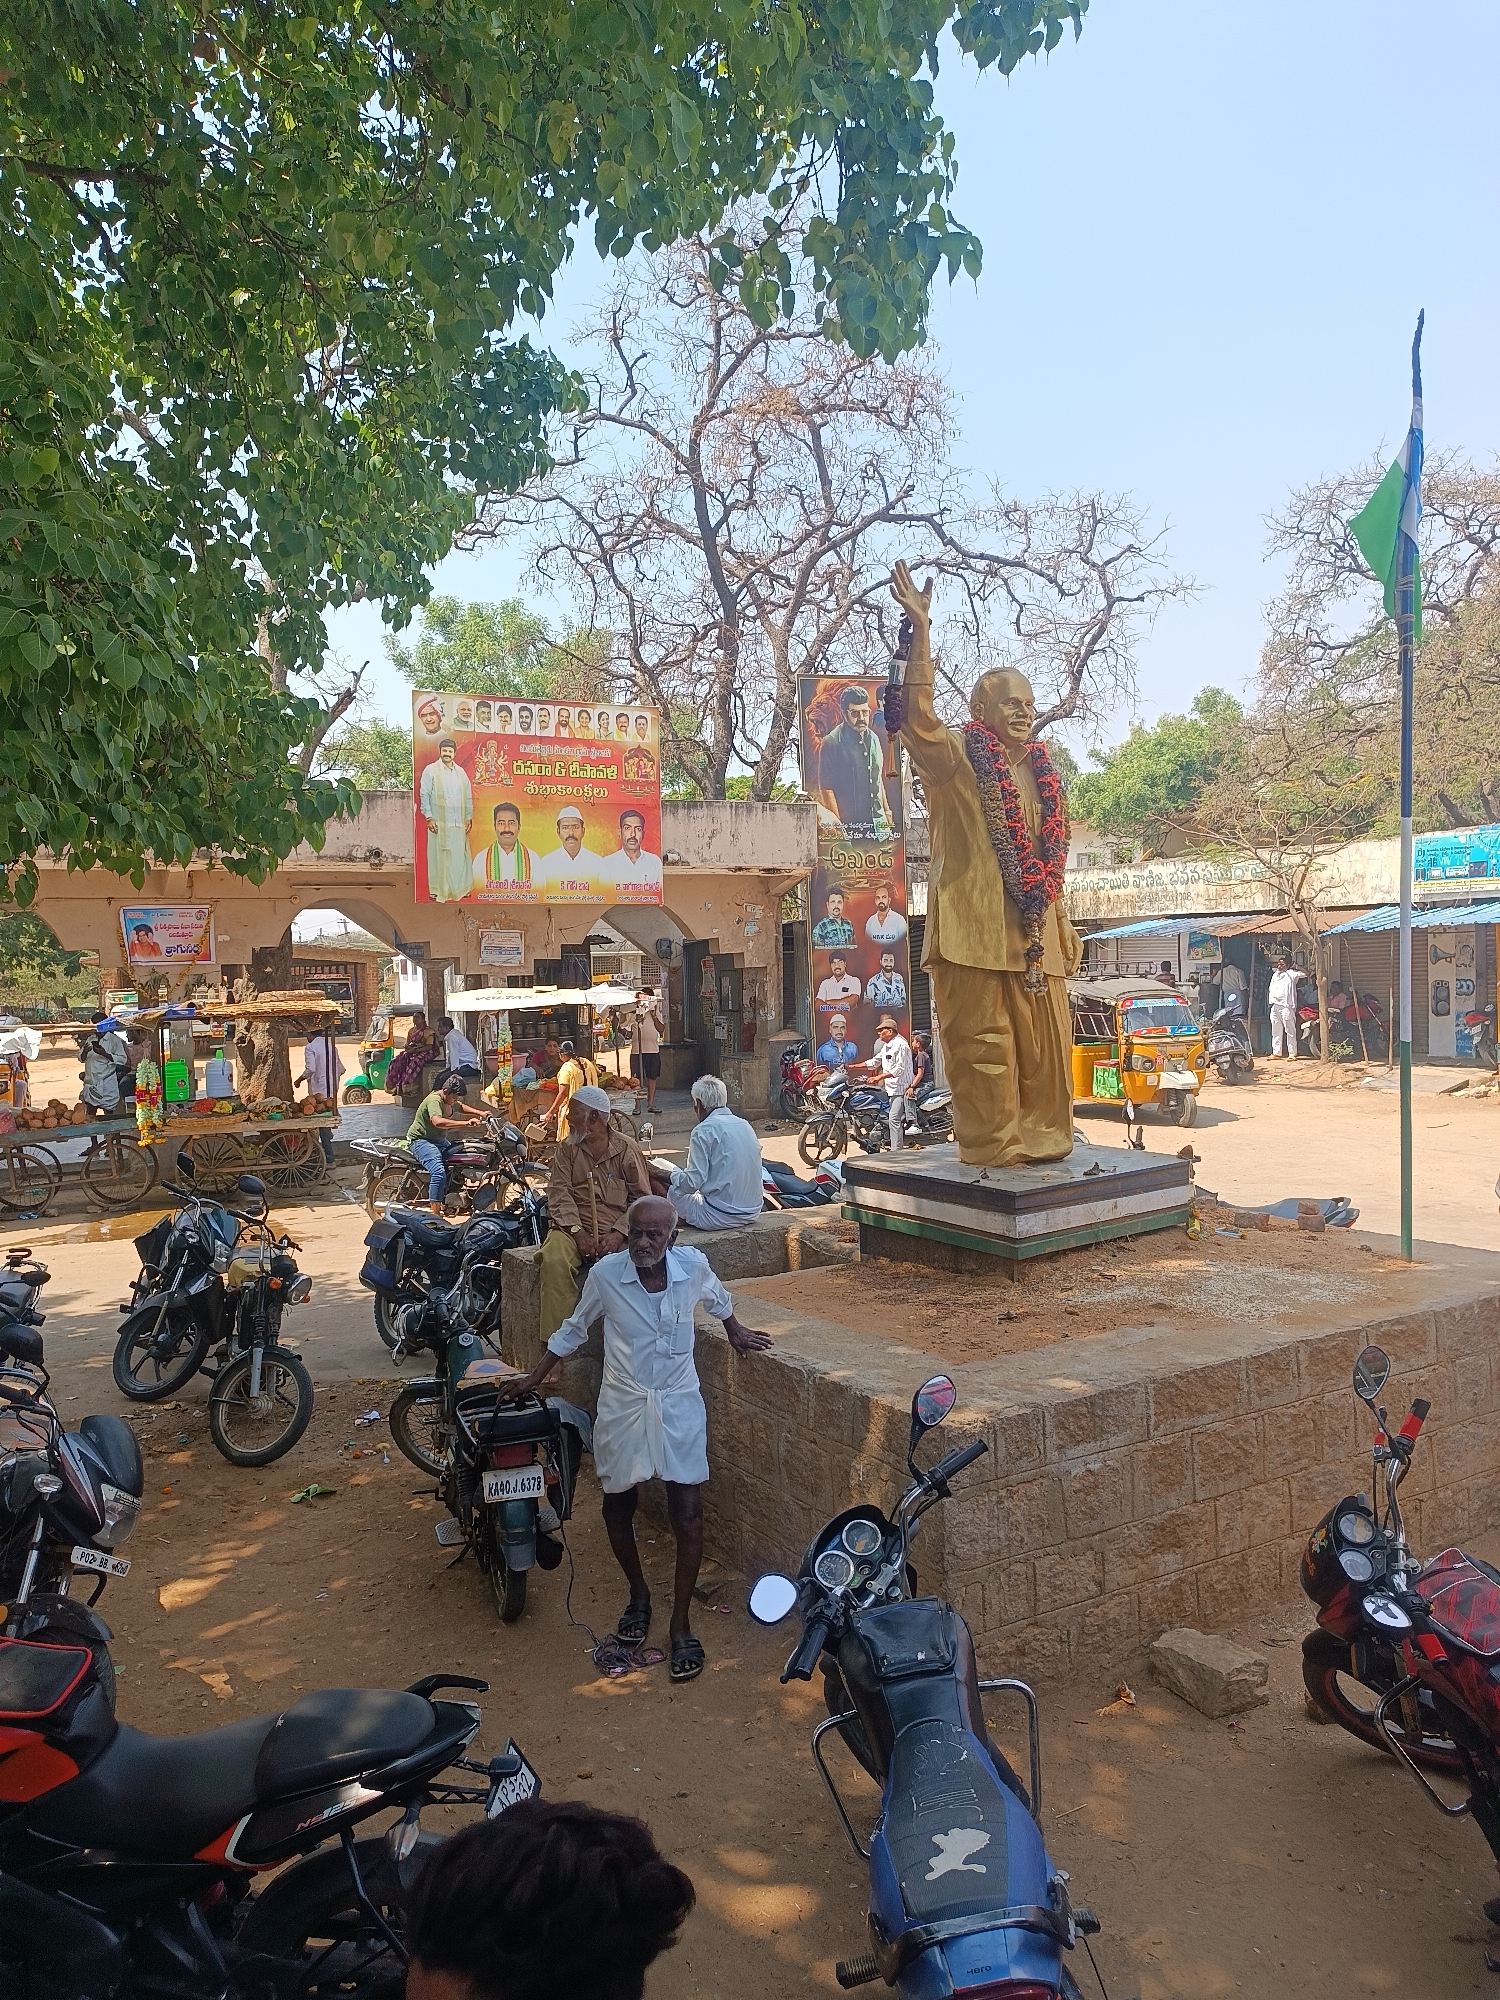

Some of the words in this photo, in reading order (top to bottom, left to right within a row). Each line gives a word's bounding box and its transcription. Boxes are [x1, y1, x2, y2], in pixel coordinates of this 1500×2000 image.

[512, 760, 552, 776] దసరా
[554, 761, 567, 777] &
[569, 761, 618, 779] దీపావళి
[523, 781, 609, 806] శుభాకాంక్షలు
[822, 842, 894, 869] అఖండ
